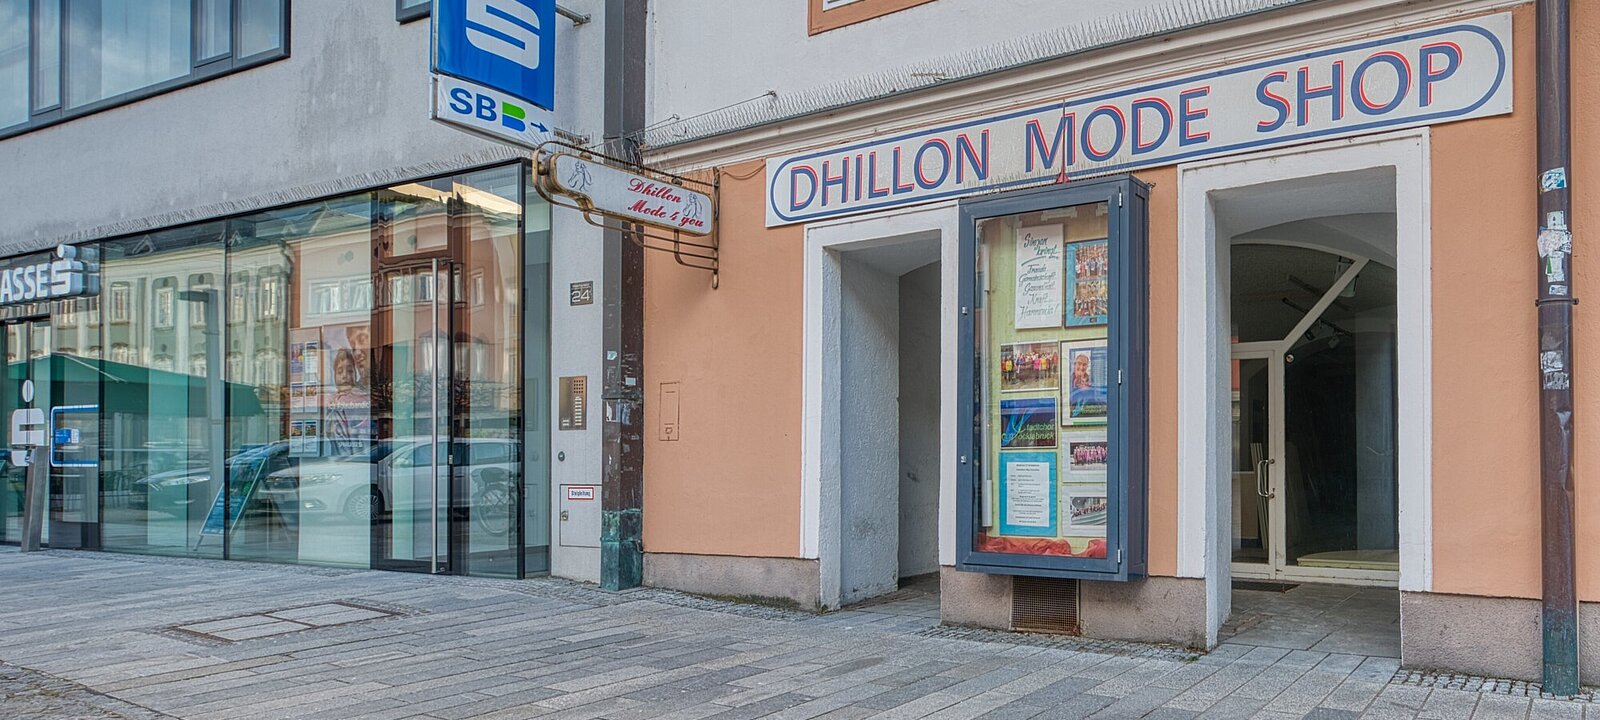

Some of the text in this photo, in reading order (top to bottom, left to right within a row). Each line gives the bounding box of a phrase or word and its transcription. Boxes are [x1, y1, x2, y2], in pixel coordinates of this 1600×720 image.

[790, 41, 1463, 212] DHILLON MODE SHOP
[627, 177, 682, 204] Dhillon
[627, 199, 704, 228] Mode 4 you
[571, 289, 590, 303] 24
